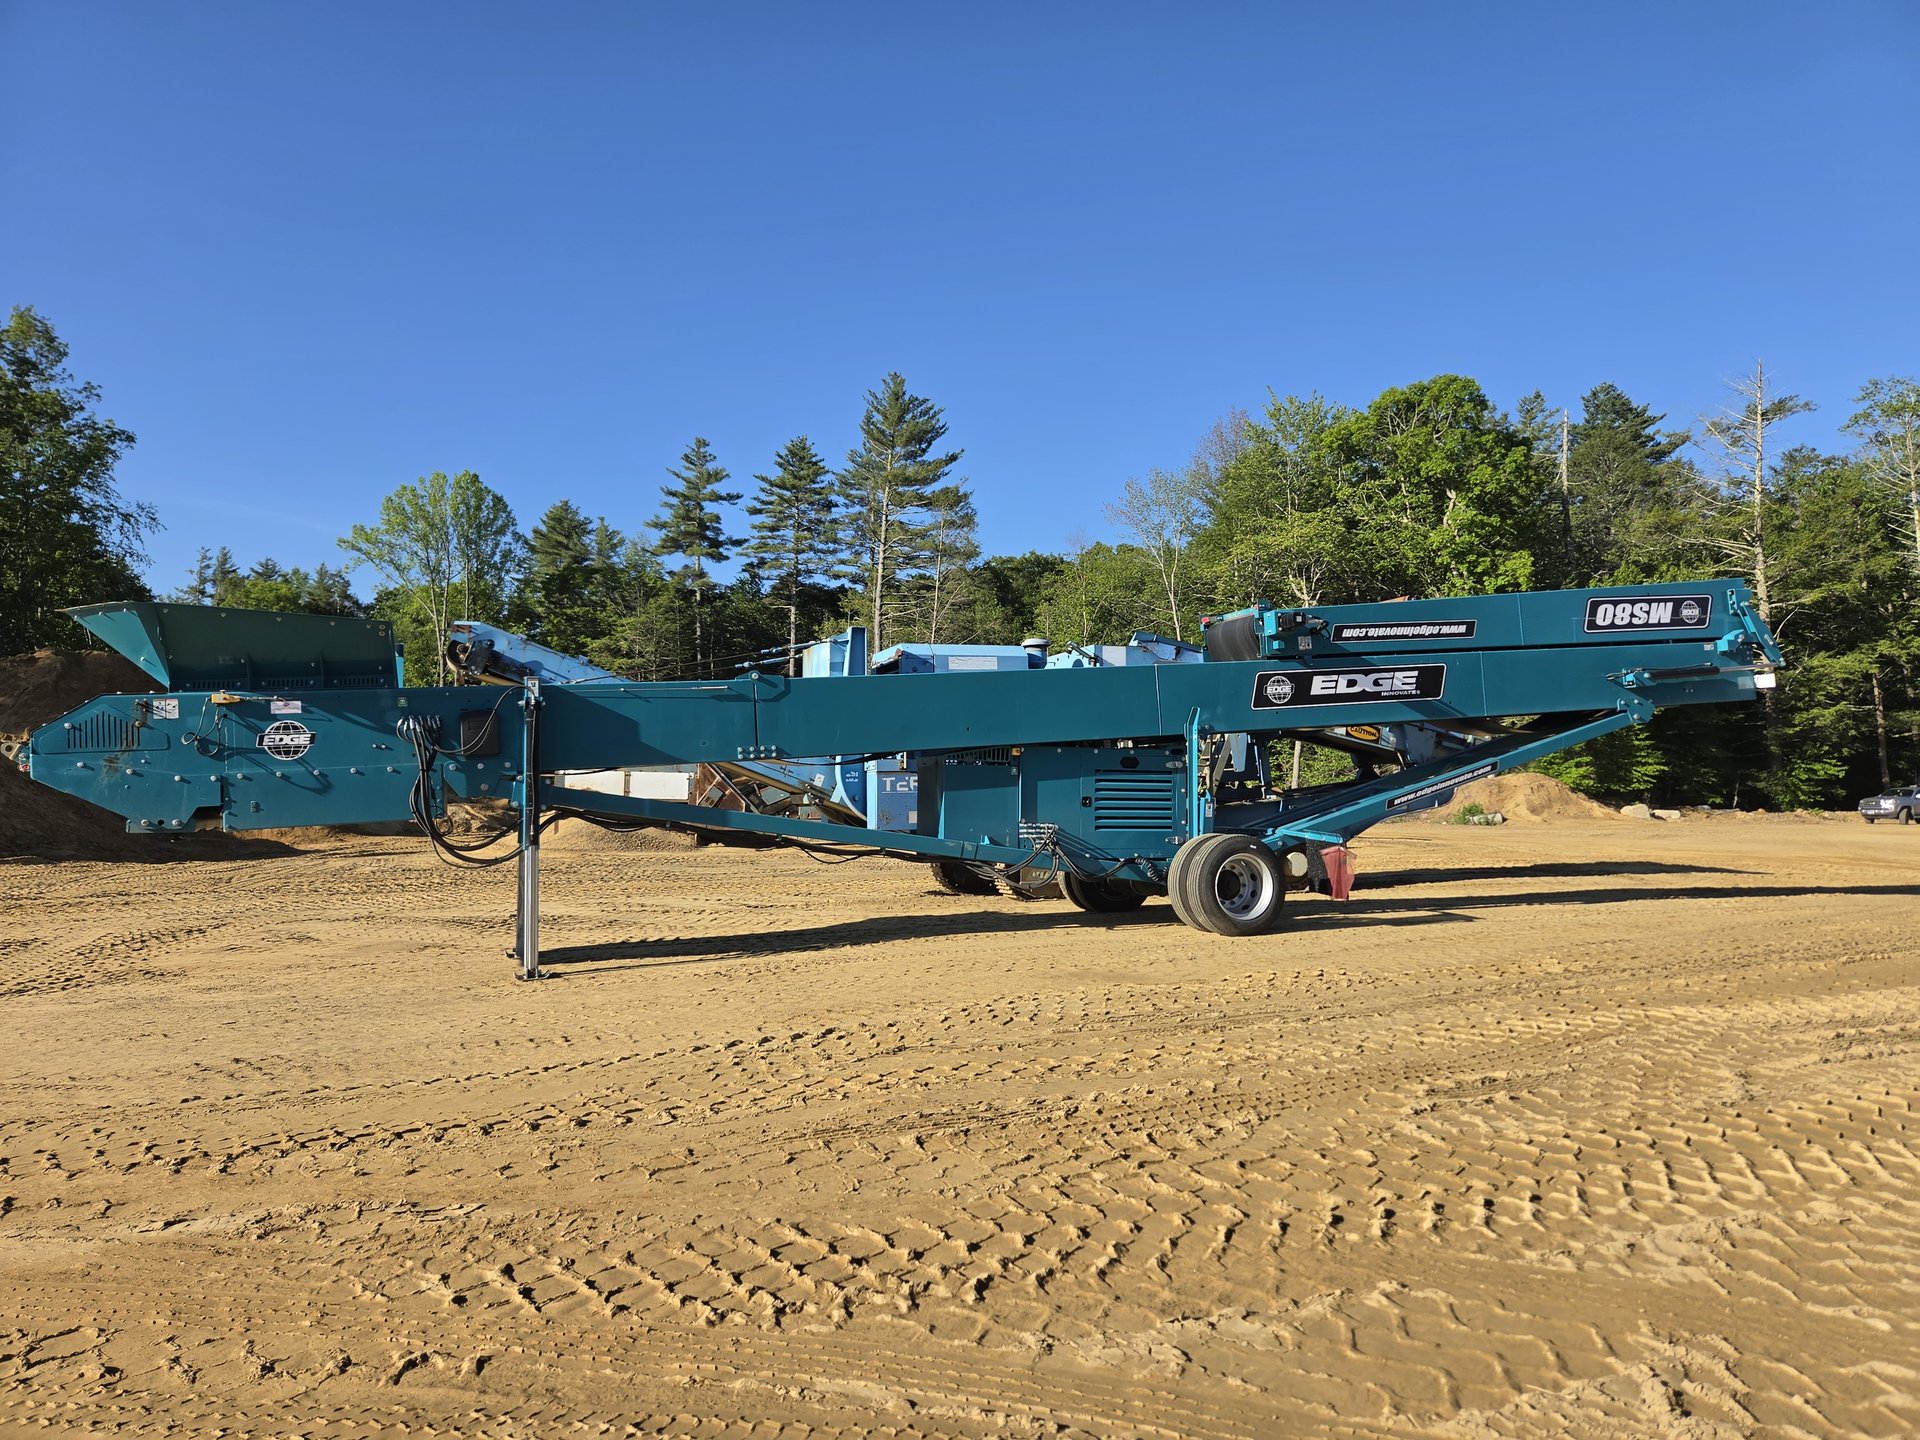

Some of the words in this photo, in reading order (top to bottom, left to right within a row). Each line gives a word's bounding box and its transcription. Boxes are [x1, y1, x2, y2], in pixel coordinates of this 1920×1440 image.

[1595, 602, 1674, 626] MS80
[1266, 685, 1293, 694] EDGE
[1310, 671, 1419, 695] EDGE
[262, 733, 312, 746] EDGE
